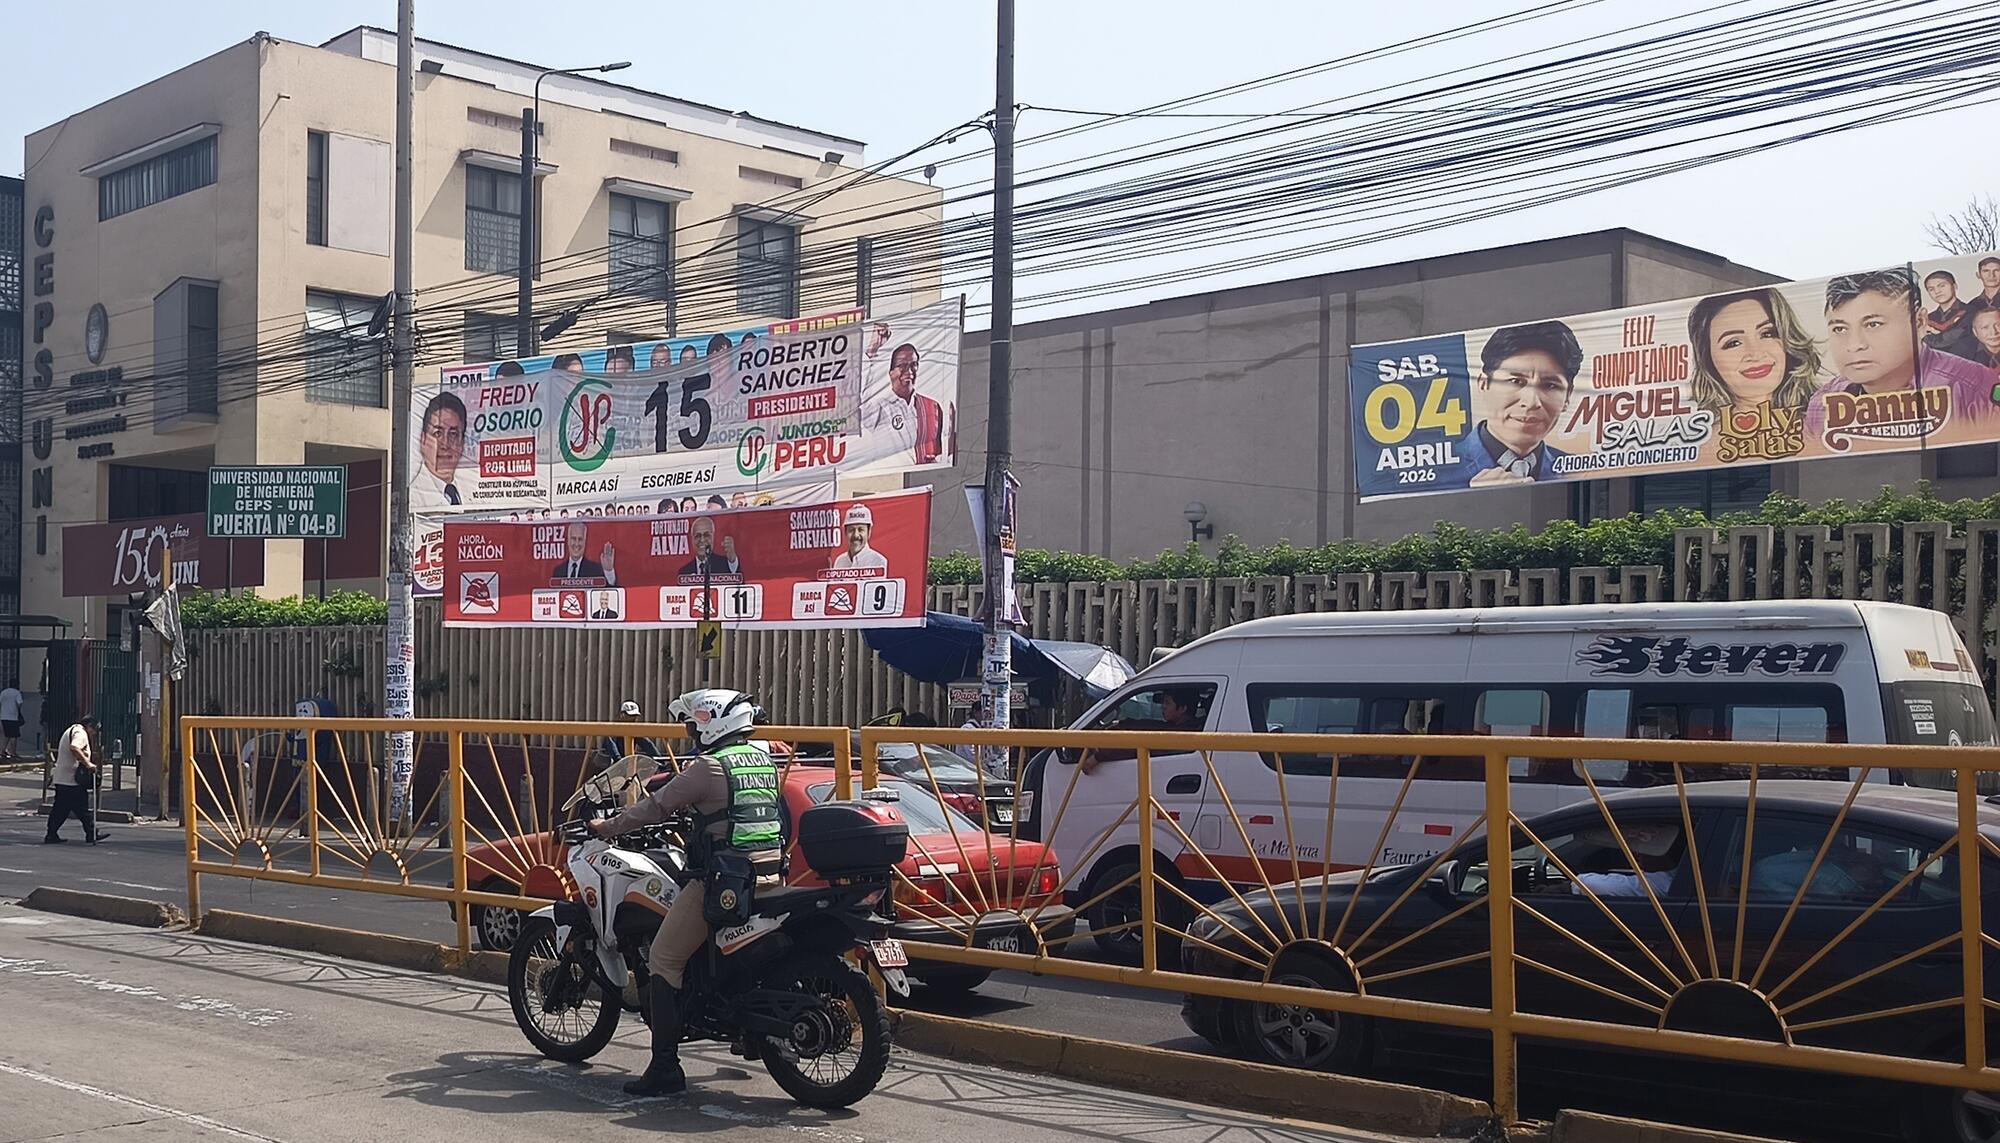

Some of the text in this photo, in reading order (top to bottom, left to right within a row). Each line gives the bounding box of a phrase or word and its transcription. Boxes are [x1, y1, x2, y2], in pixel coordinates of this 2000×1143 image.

[33, 206, 54, 390] CEPS
[1623, 315, 1655, 348] FELIZ
[738, 334, 848, 371] ROBERTO
[739, 359, 848, 394] SANCHEZ
[1377, 354, 1447, 382] SAB.
[1592, 344, 1689, 389] CUMPLEAÑOS
[479, 382, 539, 408] FREDY
[754, 391, 829, 417] PRESIDENTE
[644, 373, 712, 453] 15
[1365, 377, 1467, 444] 04
[1564, 386, 1691, 444] MIGUEL
[1825, 388, 1948, 429] Danny
[474, 408, 543, 433] OSORIO
[777, 420, 832, 440] JUNTOS
[1871, 421, 1934, 437] MENDOZA
[1601, 413, 1710, 450] SALAS
[483, 441, 533, 457] DIPUTADO
[775, 433, 846, 471] PERÚ
[1376, 442, 1460, 471] ABRIL
[1552, 446, 1697, 472] 4 HORAS EN CONCIERTO
[485, 459, 532, 473] POR LIMA
[1400, 469, 1436, 483] 2026
[32, 420, 53, 555] UNI
[212, 471, 340, 485] UNIVERSIDAD NACIONAL
[557, 475, 620, 496] MARCA ASÍ
[641, 466, 716, 489] ESCRIBE ASÍ
[236, 486, 315, 499] DE INGENIERIA
[235, 500, 272, 511] CEPS
[288, 500, 314, 511] UNI
[213, 514, 272, 535] PUERTA
[299, 514, 336, 535] 04-B
[651, 519, 689, 536] FORTUNATO
[790, 509, 840, 530] SALVADOR
[169, 523, 190, 538] Años
[458, 535, 485, 545] AHORA
[532, 526, 565, 543] LOPEZ
[790, 528, 841, 550] AREVALO
[458, 540, 503, 559] NACIÓN
[533, 543, 565, 560] CHAU
[651, 535, 690, 556] ALVA
[172, 560, 200, 585] UNI
[826, 569, 875, 578] DIPUTADO LIMA
[538, 596, 556, 605] MARCA
[666, 595, 686, 604] MARCA
[732, 591, 747, 614] 11
[800, 591, 822, 601] MARCA
[873, 585, 886, 611] 9
[671, 606, 681, 616] ASÍ
[804, 602, 814, 613] ASÍ
[1576, 634, 1847, 677] Steven
[728, 753, 772, 767] POLICIA
[737, 774, 776, 789] TRANSITO
[607, 858, 622, 869] 105
